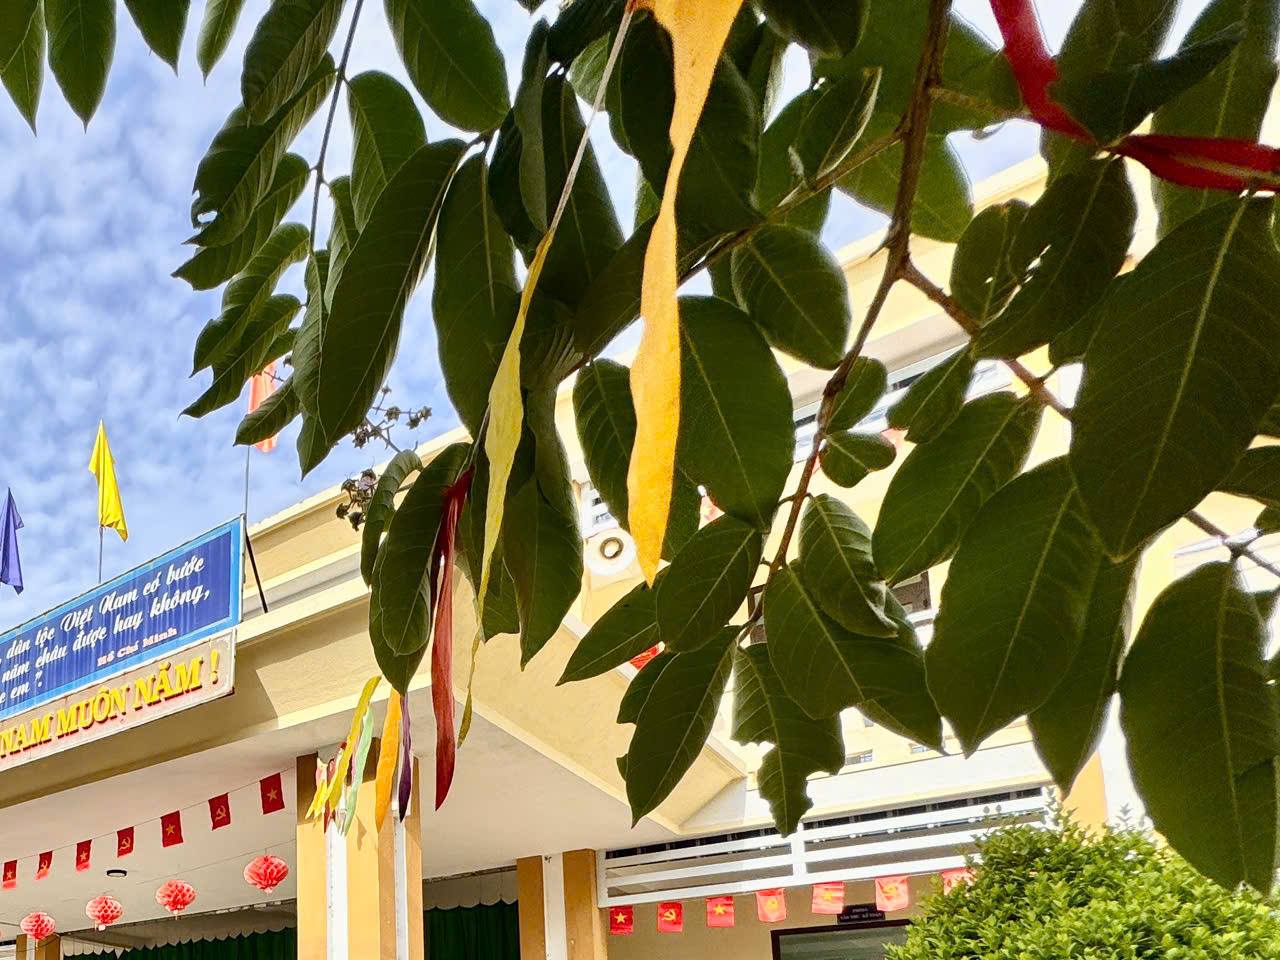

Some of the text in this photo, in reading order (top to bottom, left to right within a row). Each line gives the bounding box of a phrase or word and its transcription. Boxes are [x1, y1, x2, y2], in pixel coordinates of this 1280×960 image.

[1, 662, 30, 682] năm
[36, 645, 68, 668] châu
[73, 626, 107, 652] được
[114, 610, 143, 634] hay
[150, 584, 210, 618] không,
[6, 640, 31, 659] dân
[35, 627, 56, 647] tộc
[61, 605, 93, 631] Việt
[99, 588, 140, 614] Nam
[143, 573, 162, 595] có
[166, 556, 205, 584] bước
[0, 713, 53, 757] NAM
[55, 686, 130, 737] MUÔN
[135, 661, 203, 711] NĂM
[210, 649, 220, 685] !
[11, 682, 30, 698] em
